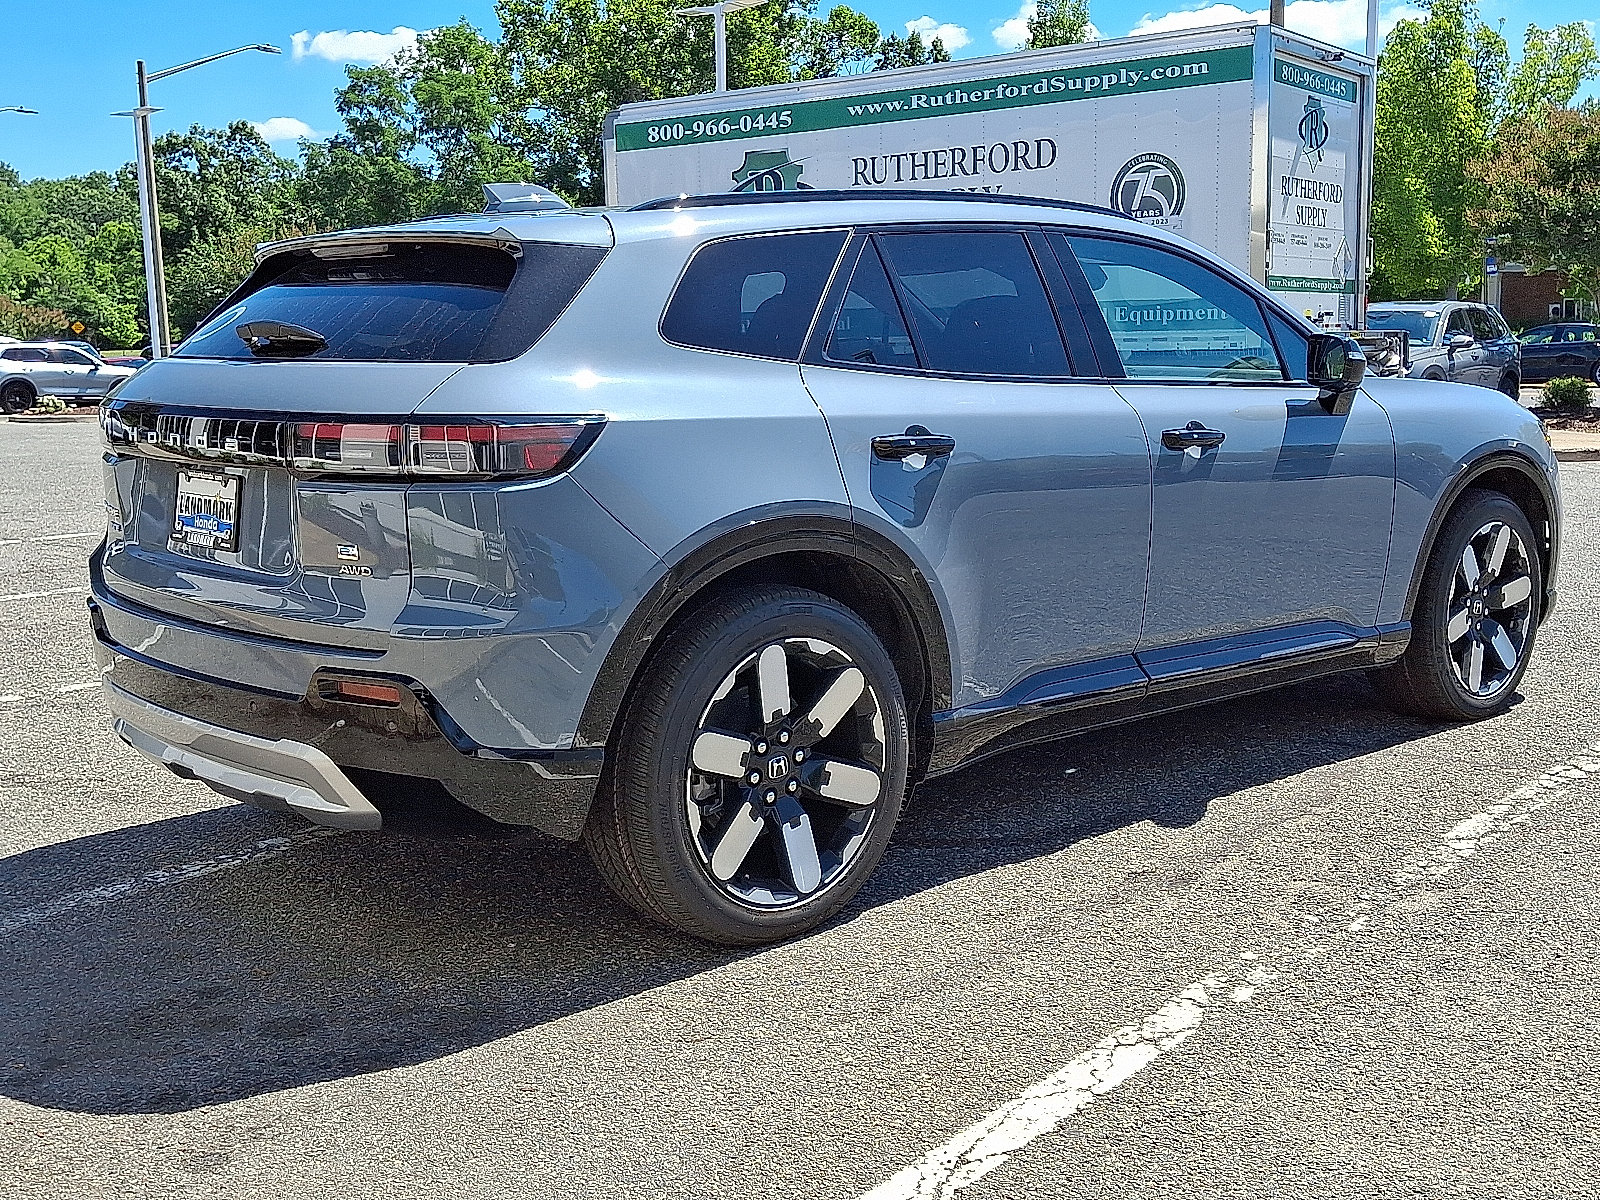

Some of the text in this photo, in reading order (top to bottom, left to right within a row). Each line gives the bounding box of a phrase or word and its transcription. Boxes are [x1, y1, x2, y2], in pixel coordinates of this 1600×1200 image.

[847, 61, 1210, 117] www.RutherfordSupply.com
[1281, 64, 1347, 97] 800-966-0445
[647, 110, 793, 143] 800-966-0445
[851, 138, 1058, 187] RUTHERFORD
[1127, 154, 1169, 169] CELEBRATING
[1281, 175, 1343, 204] RUTHERFORD
[1131, 209, 1161, 218] YEARS
[1296, 205, 1328, 228] SUPPLY
[179, 494, 234, 522] LANDMARK
[194, 515, 219, 531] Honda
[339, 564, 372, 577] AWD
